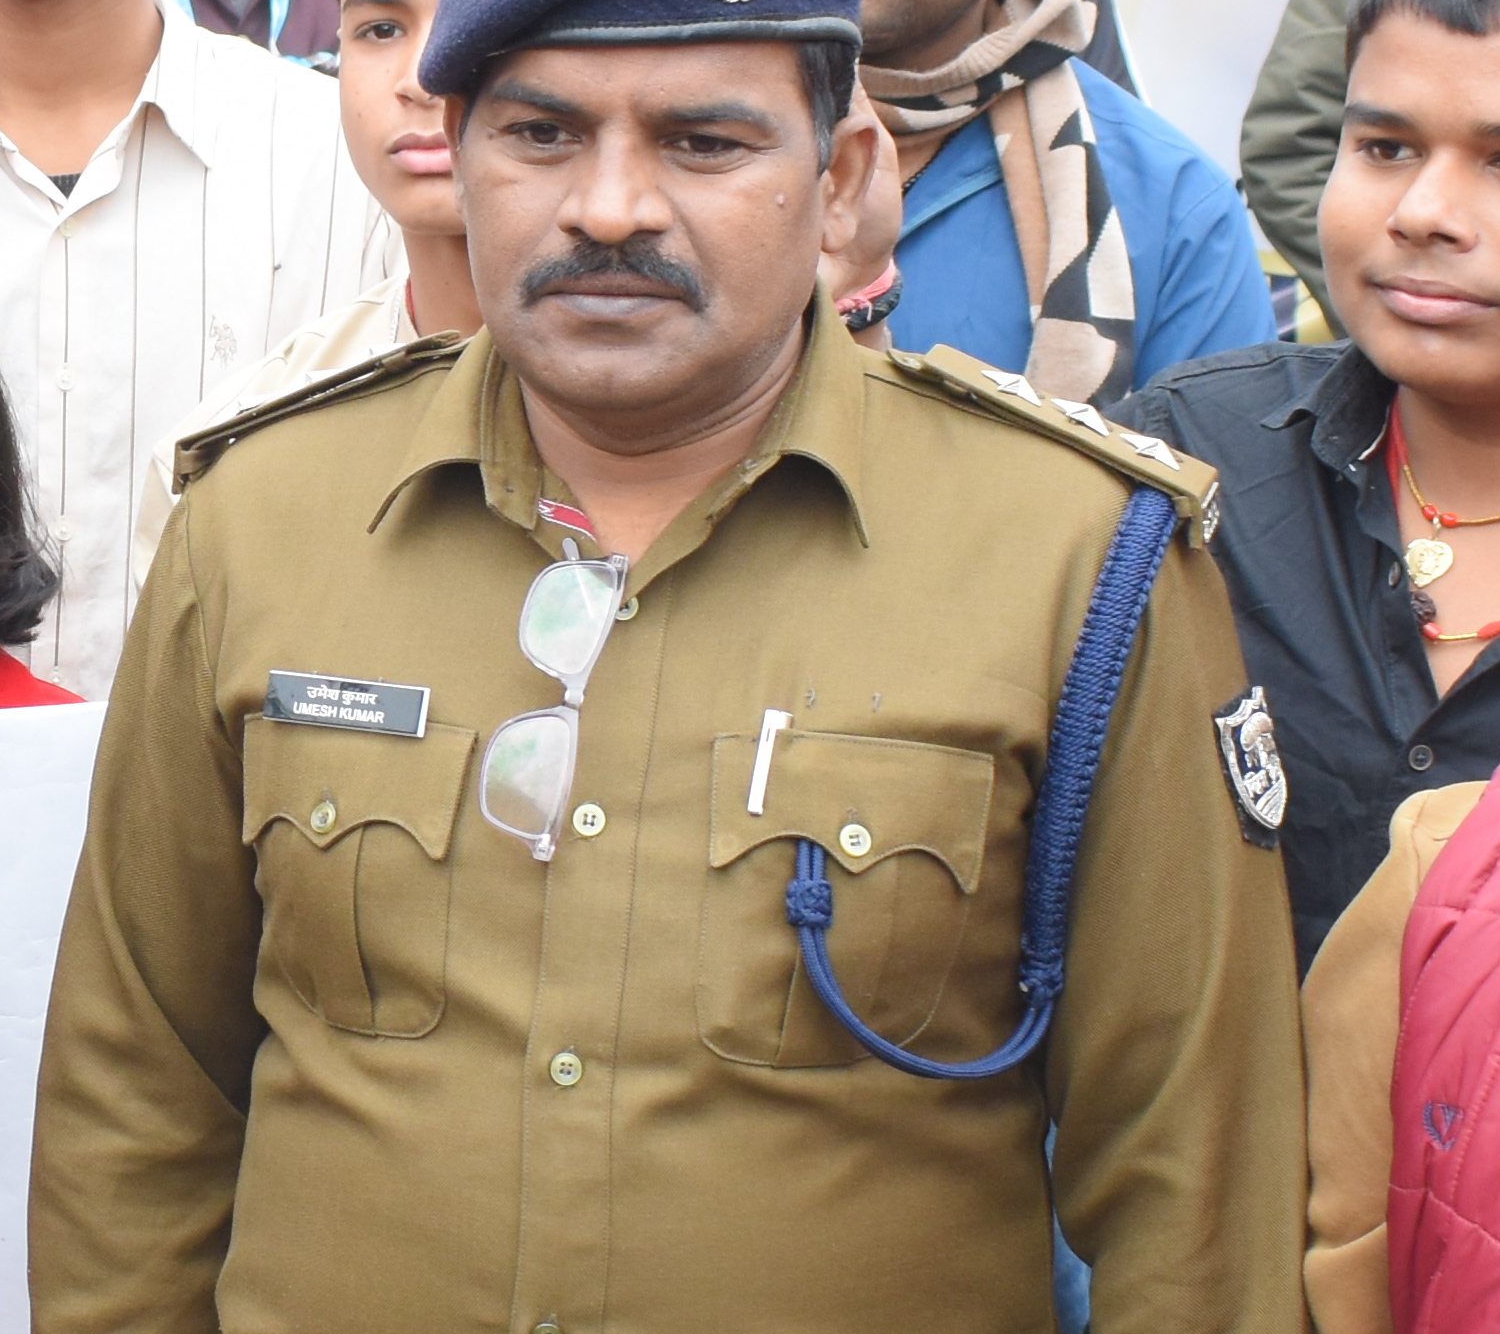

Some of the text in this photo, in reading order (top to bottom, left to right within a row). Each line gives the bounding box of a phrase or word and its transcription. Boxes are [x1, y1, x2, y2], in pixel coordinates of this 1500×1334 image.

[306, 684, 379, 706] उमेश कुमार
[292, 701, 386, 724] UMESH KUMAR
